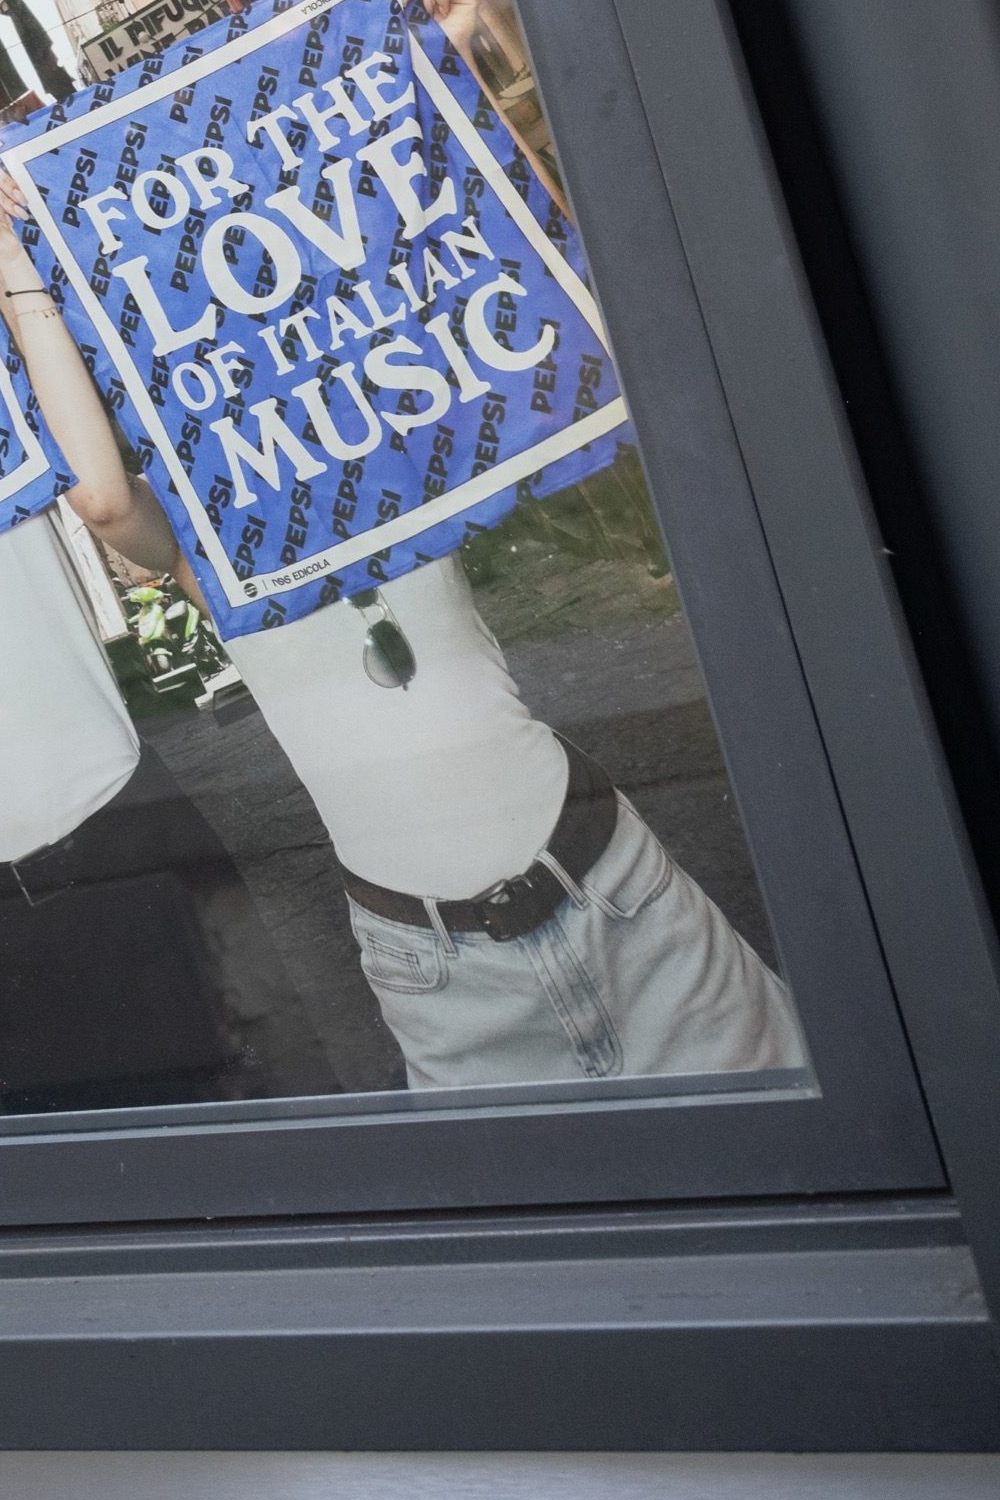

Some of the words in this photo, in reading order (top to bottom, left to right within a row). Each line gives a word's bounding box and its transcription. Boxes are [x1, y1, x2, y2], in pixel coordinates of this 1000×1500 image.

[98, 36, 124, 63] IL
[63, 149, 97, 227] PEPSI
[79, 146, 250, 255] FOR
[246, 51, 416, 173] THE
[112, 116, 457, 358] LOVE
[171, 208, 206, 292] PEPSI
[171, 342, 245, 411] OF
[256, 216, 496, 377] ITALIAN
[208, 272, 556, 510] MUSIC
[281, 478, 311, 566] PEPSI
[293, 558, 331, 581] EDICOLA
